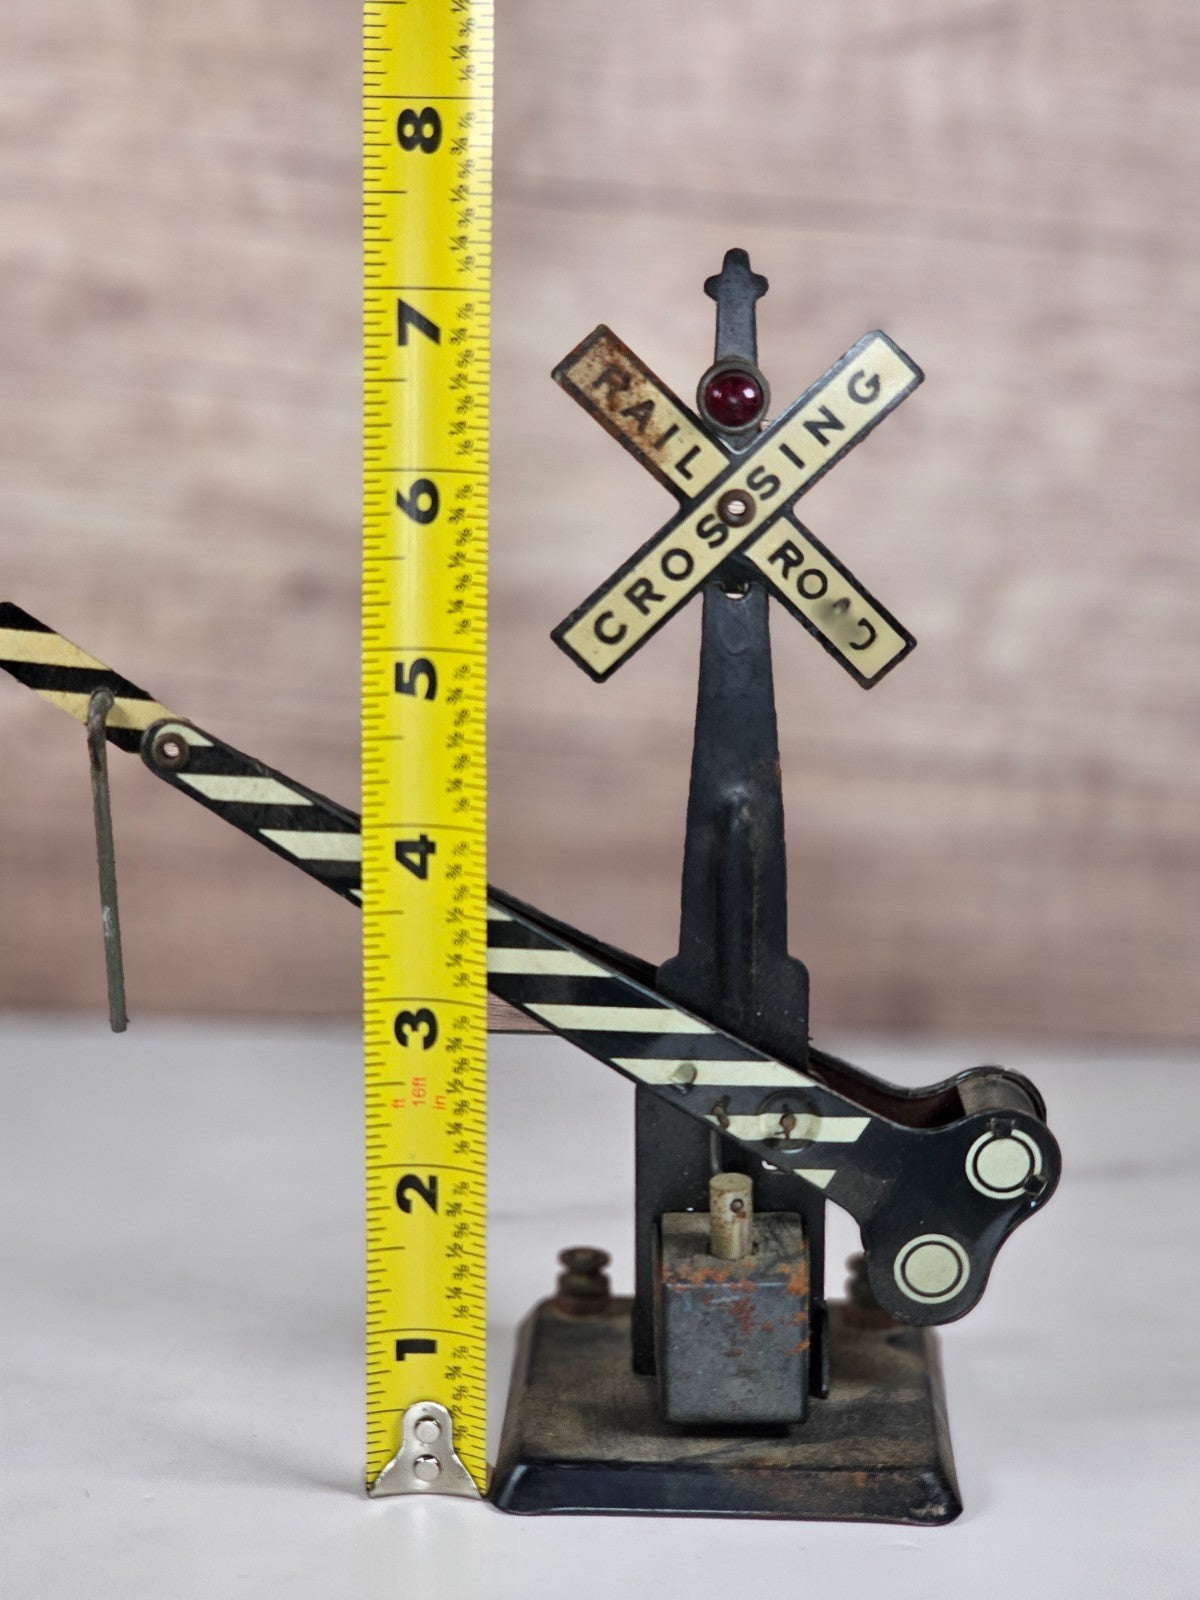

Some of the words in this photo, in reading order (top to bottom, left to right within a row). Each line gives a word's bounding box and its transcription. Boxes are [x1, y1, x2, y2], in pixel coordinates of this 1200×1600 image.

[396, 107, 442, 154] 8
[398, 298, 440, 346] 7
[593, 365, 703, 481] RAIL
[396, 478, 439, 525] 6
[593, 369, 881, 646] CROSSING
[395, 658, 437, 700] 5
[395, 835, 436, 880] 4
[394, 1008, 438, 1050] 3
[391, 1098, 405, 1109] ft
[412, 1077, 426, 1107] 16ft
[434, 1095, 446, 1110] in
[396, 1174, 438, 1214] 2
[396, 1339, 437, 1361] 1
